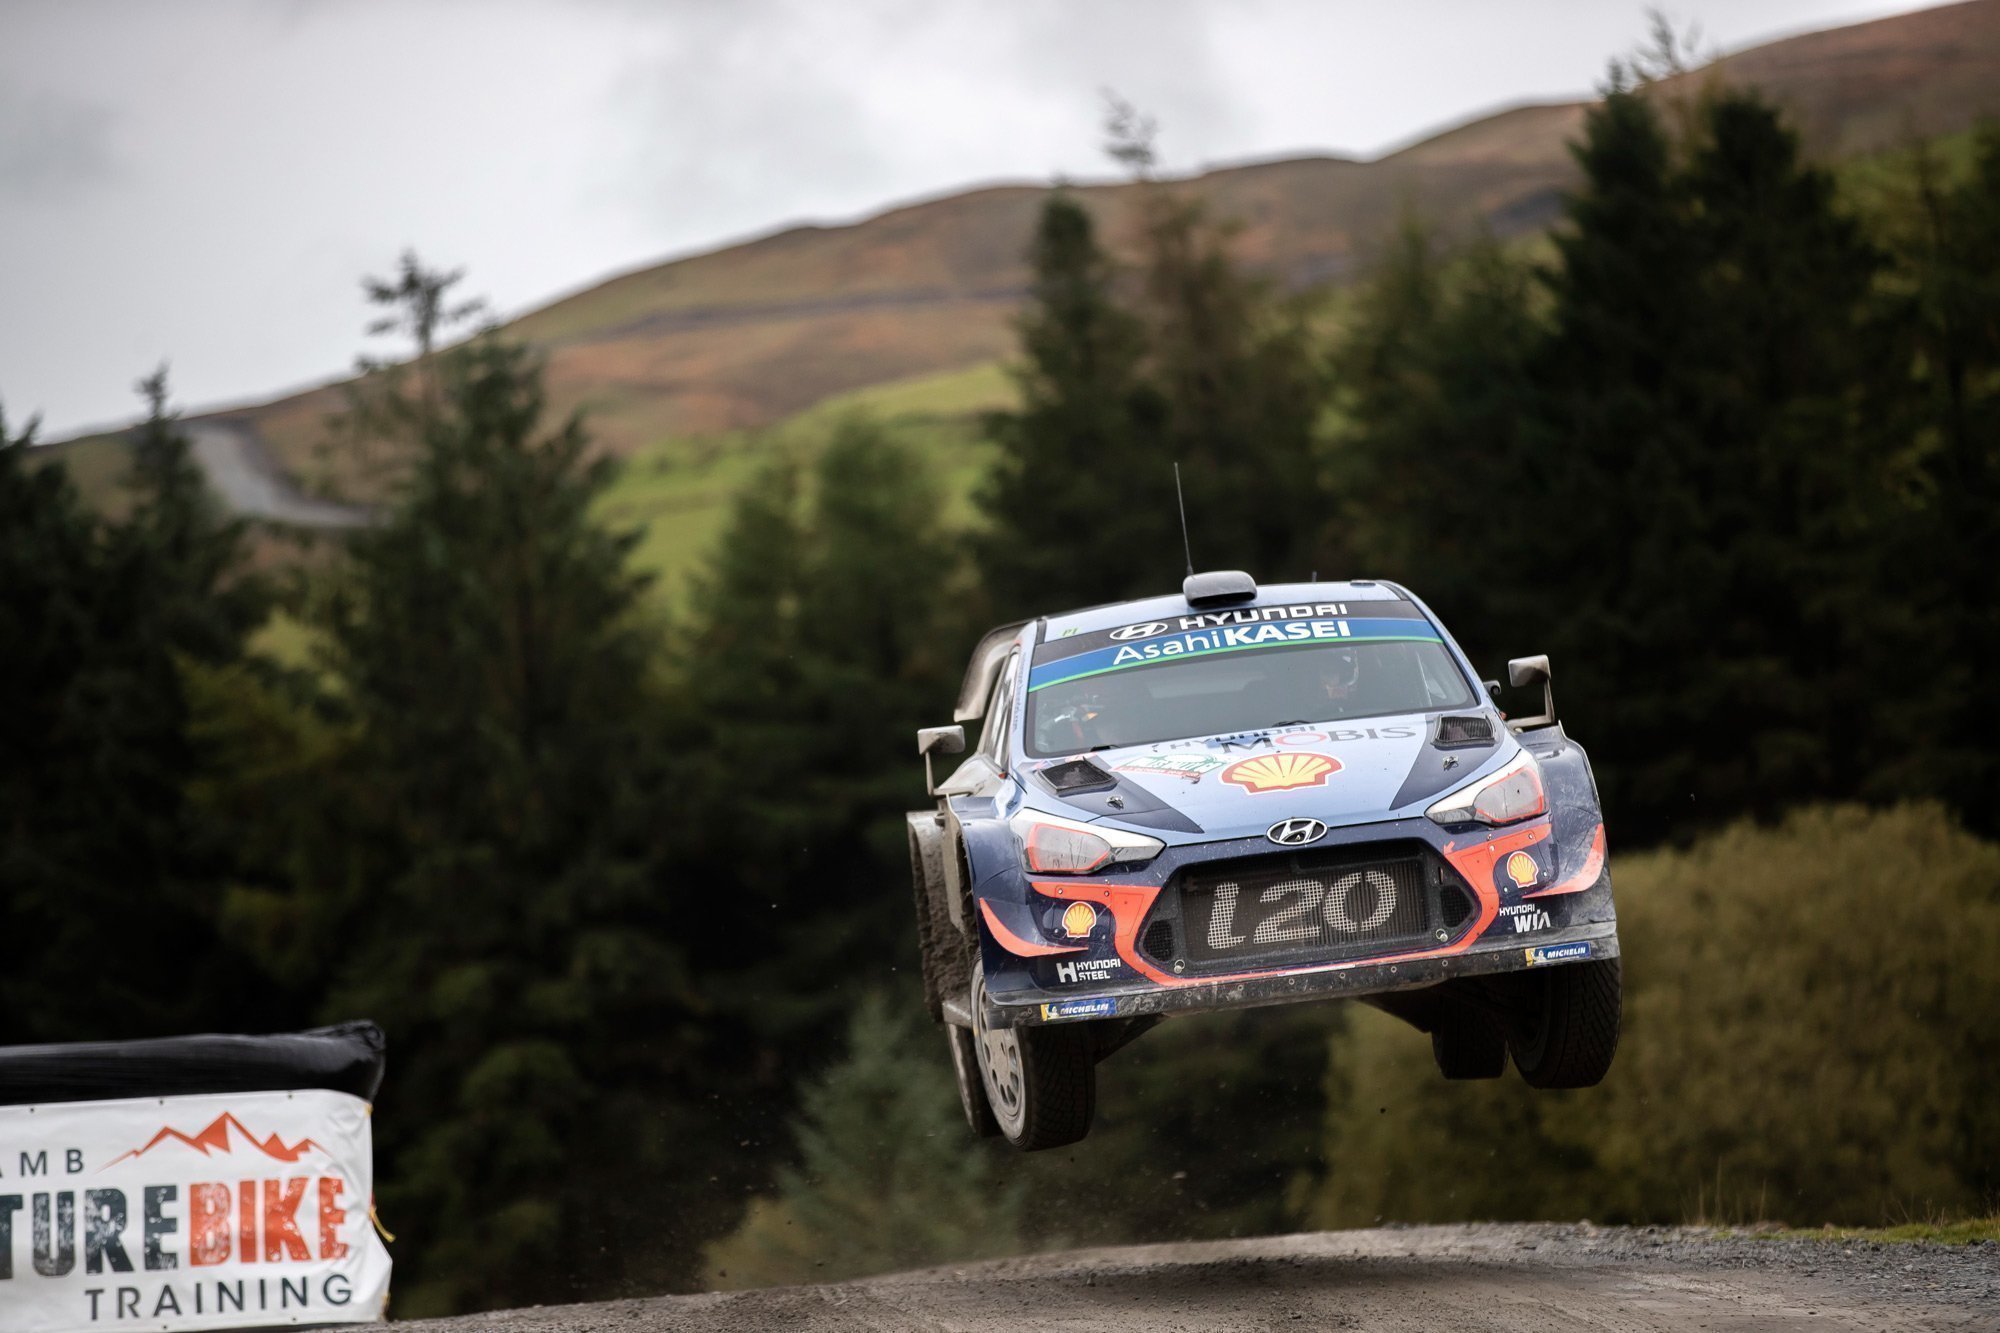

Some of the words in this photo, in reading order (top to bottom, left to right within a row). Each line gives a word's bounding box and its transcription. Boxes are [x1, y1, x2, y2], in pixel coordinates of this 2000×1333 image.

[1180, 603, 1347, 630] HYUNDAI
[1221, 725, 1417, 753] MOBIS
[1499, 904, 1535, 916] HYUNDAI
[1547, 946, 1586, 959] MICHELIN
[1076, 958, 1121, 971] HYUNDAI
[1078, 970, 1110, 980] STEEL
[1060, 1003, 1109, 1015] MICHELIN
[0, 1149, 84, 1178] MB
[84, 1274, 353, 1321] TRAINING
